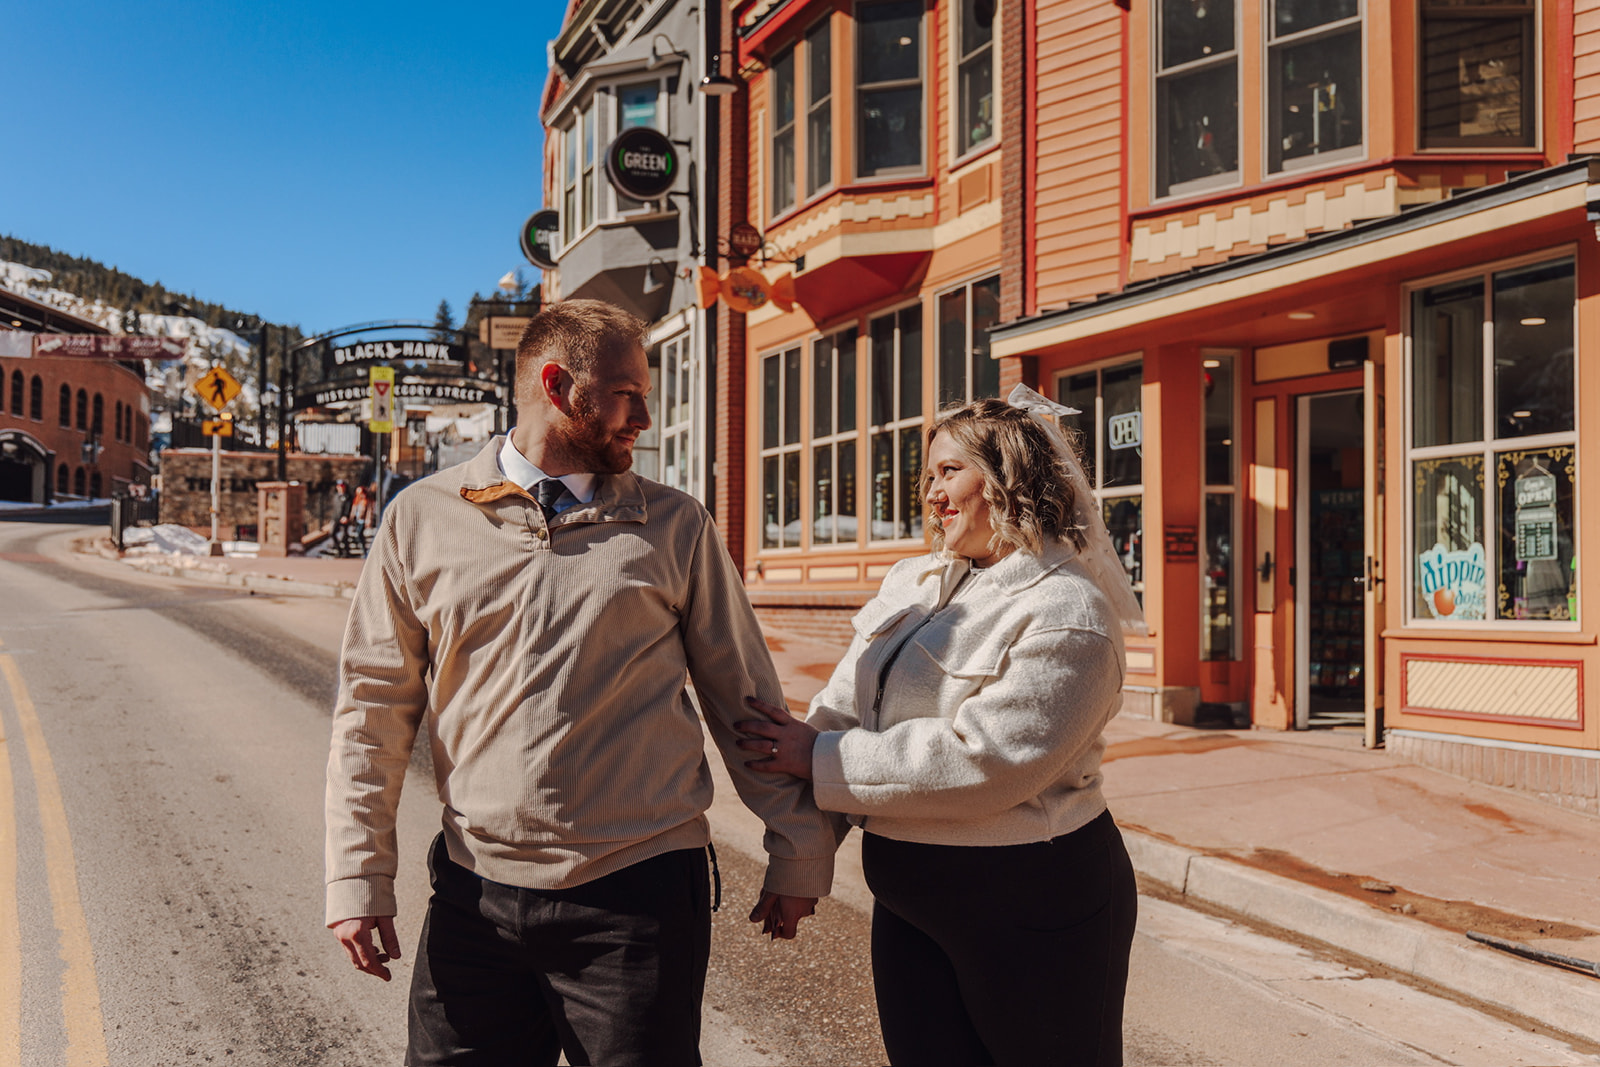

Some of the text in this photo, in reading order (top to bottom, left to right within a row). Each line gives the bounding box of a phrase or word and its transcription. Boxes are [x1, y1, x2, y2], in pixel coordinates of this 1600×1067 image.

[624, 151, 667, 172] GREEN
[334, 341, 450, 365] BLACK HAWK
[315, 386, 373, 405] HISTORIC
[436, 386, 485, 402] STREET
[1112, 415, 1140, 447] OPEN
[1518, 487, 1553, 505] OPEN
